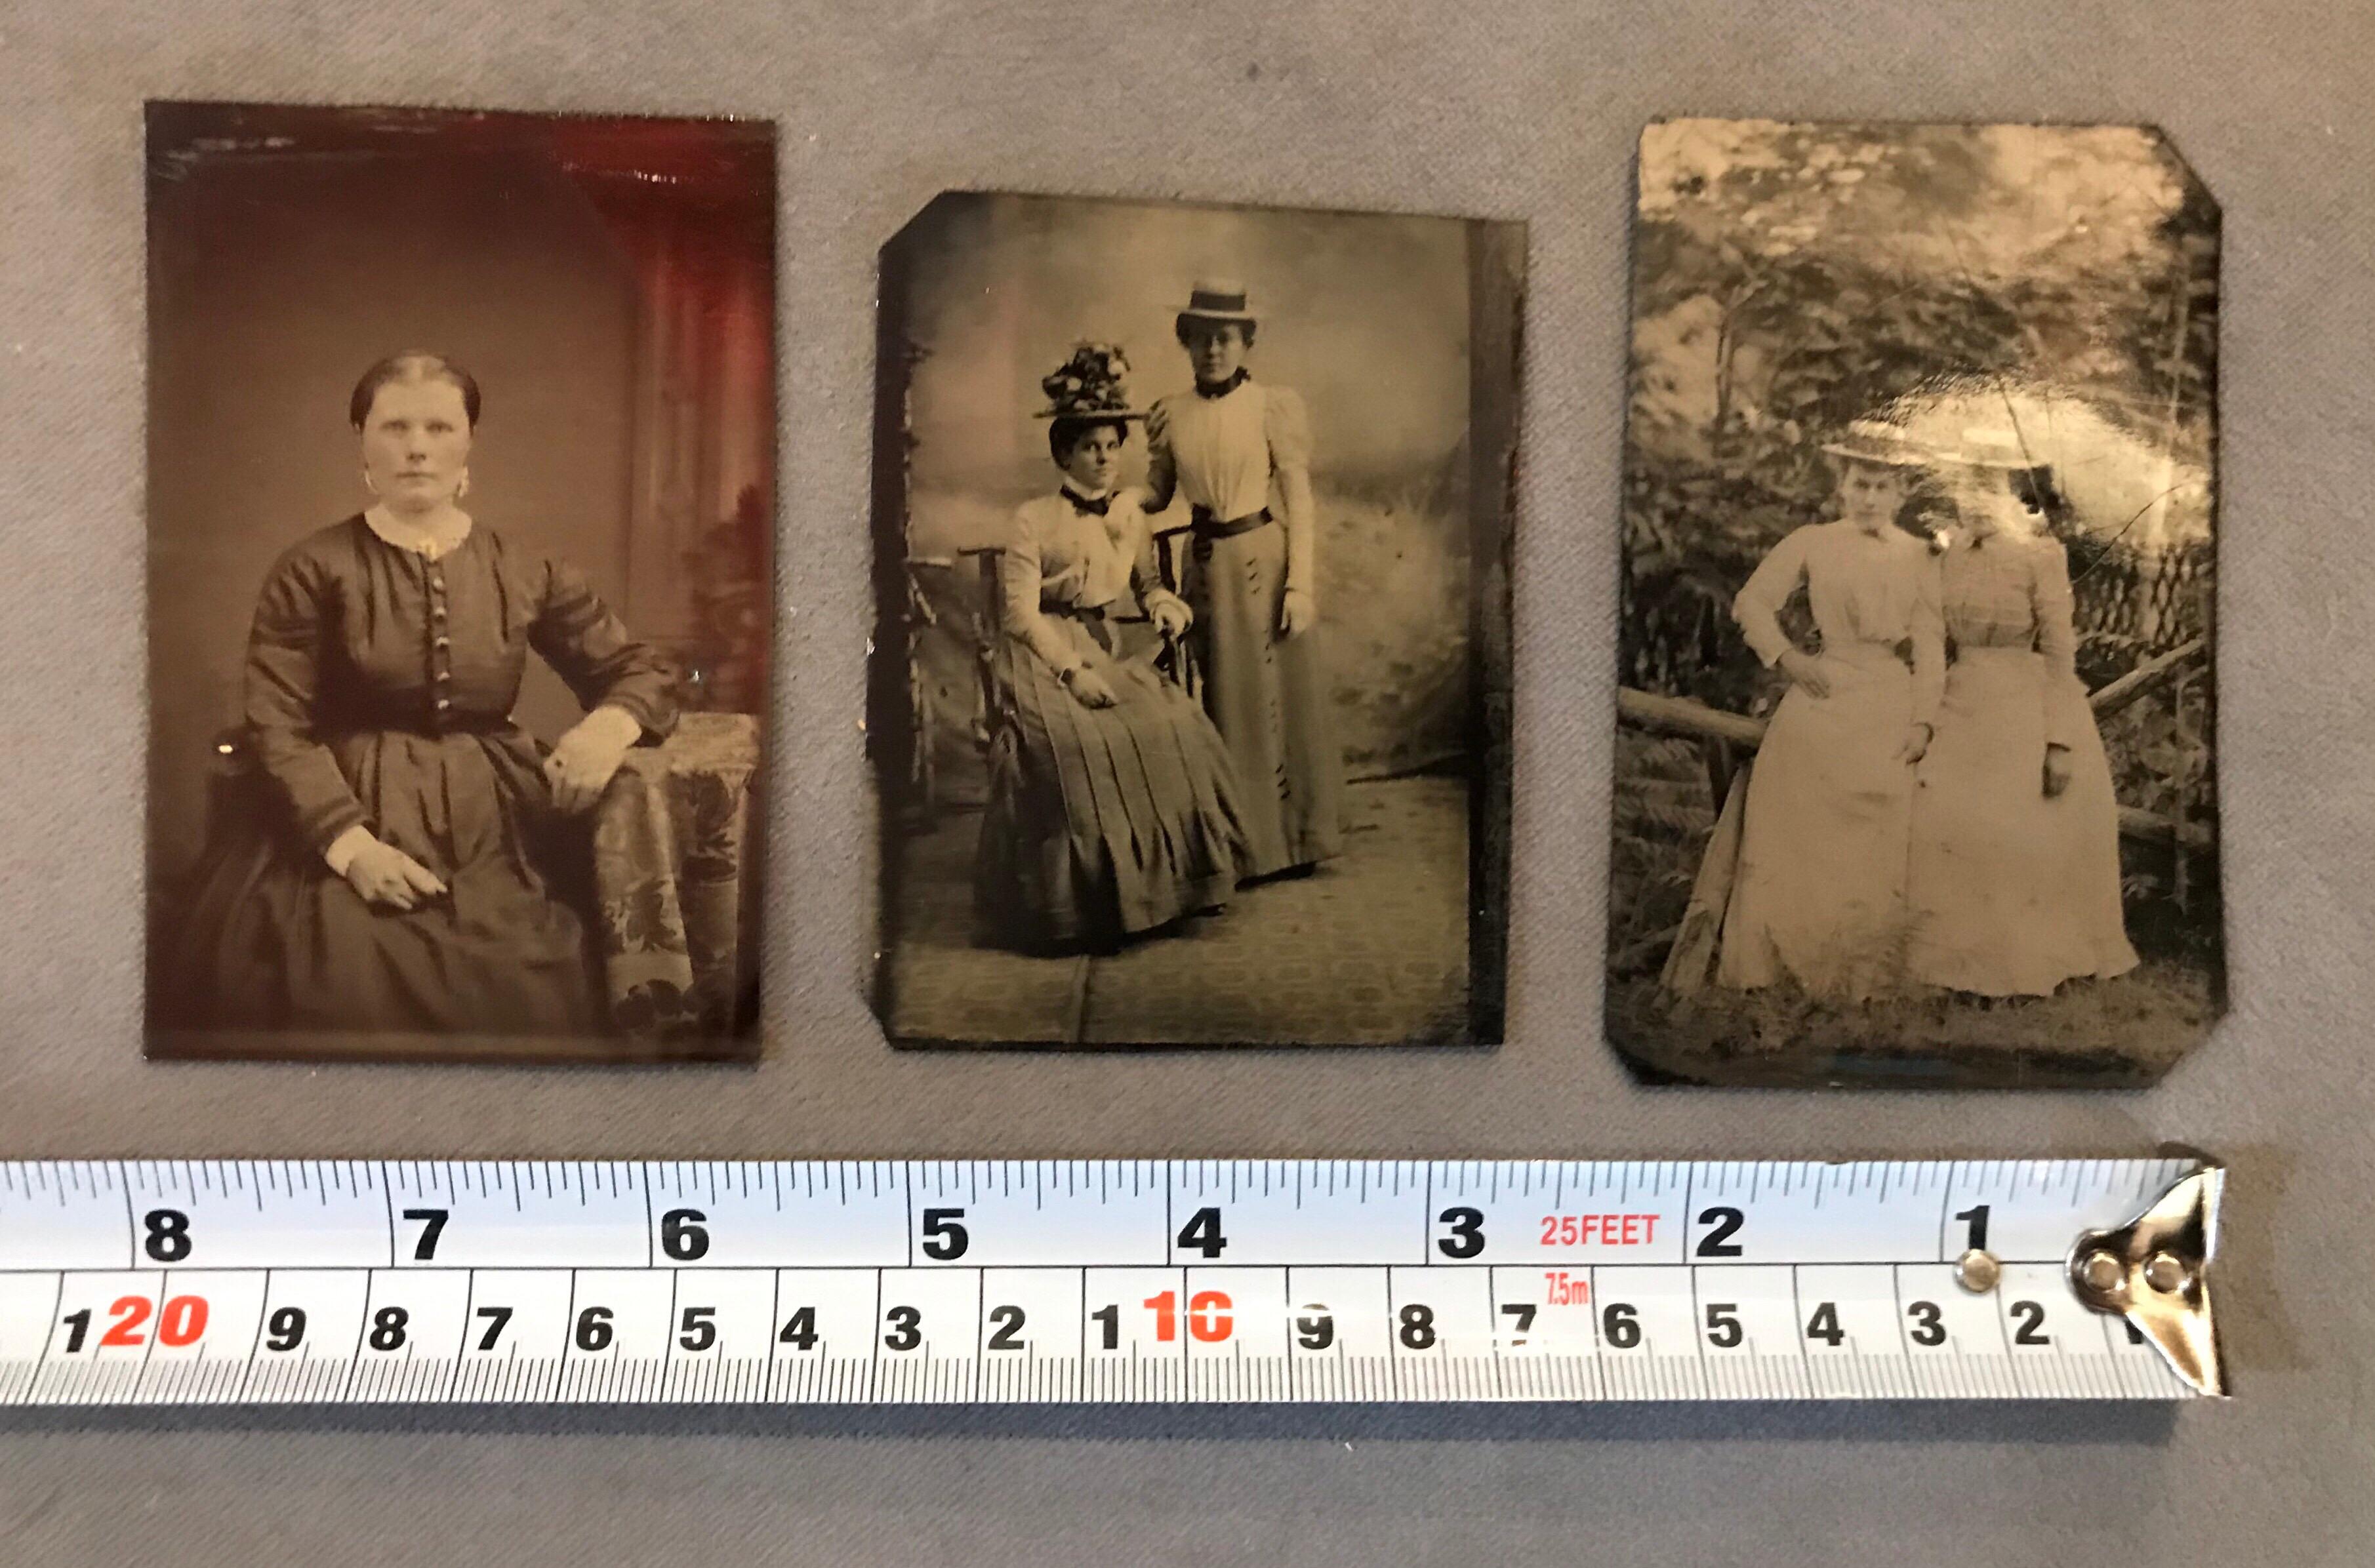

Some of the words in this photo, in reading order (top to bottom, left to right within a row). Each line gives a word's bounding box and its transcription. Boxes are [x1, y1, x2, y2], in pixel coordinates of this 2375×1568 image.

[144, 1209, 192, 1262] 8
[403, 1209, 449, 1260] 7
[661, 1209, 710, 1261] 6
[923, 1208, 969, 1260] 5
[1177, 1207, 1227, 1258] 4
[1438, 1207, 1485, 1259] 3
[1696, 1207, 1744, 1257] 2
[1956, 1205, 1990, 1251] 1
[1545, 1272, 1589, 1306] 7.5m
[100, 1295, 209, 1346] 20
[266, 1307, 306, 1352] 9
[369, 1306, 409, 1351] 8
[477, 1307, 513, 1350] 7
[576, 1306, 613, 1352] 6
[680, 1307, 716, 1351] 5
[779, 1307, 819, 1350] 4
[885, 1306, 922, 1351] 3
[988, 1306, 1025, 1350] 2
[1092, 1305, 1118, 1350] 1
[1143, 1290, 1233, 1342] 10
[1296, 1303, 1334, 1350] 9
[1399, 1304, 1436, 1350] 8
[1501, 1304, 1537, 1346] 7
[1603, 1303, 1641, 1348] 6
[1707, 1304, 1742, 1348] 5
[1807, 1302, 1844, 1346] 4
[1909, 1302, 1946, 1346] 3
[2010, 1301, 2050, 1345] 2
